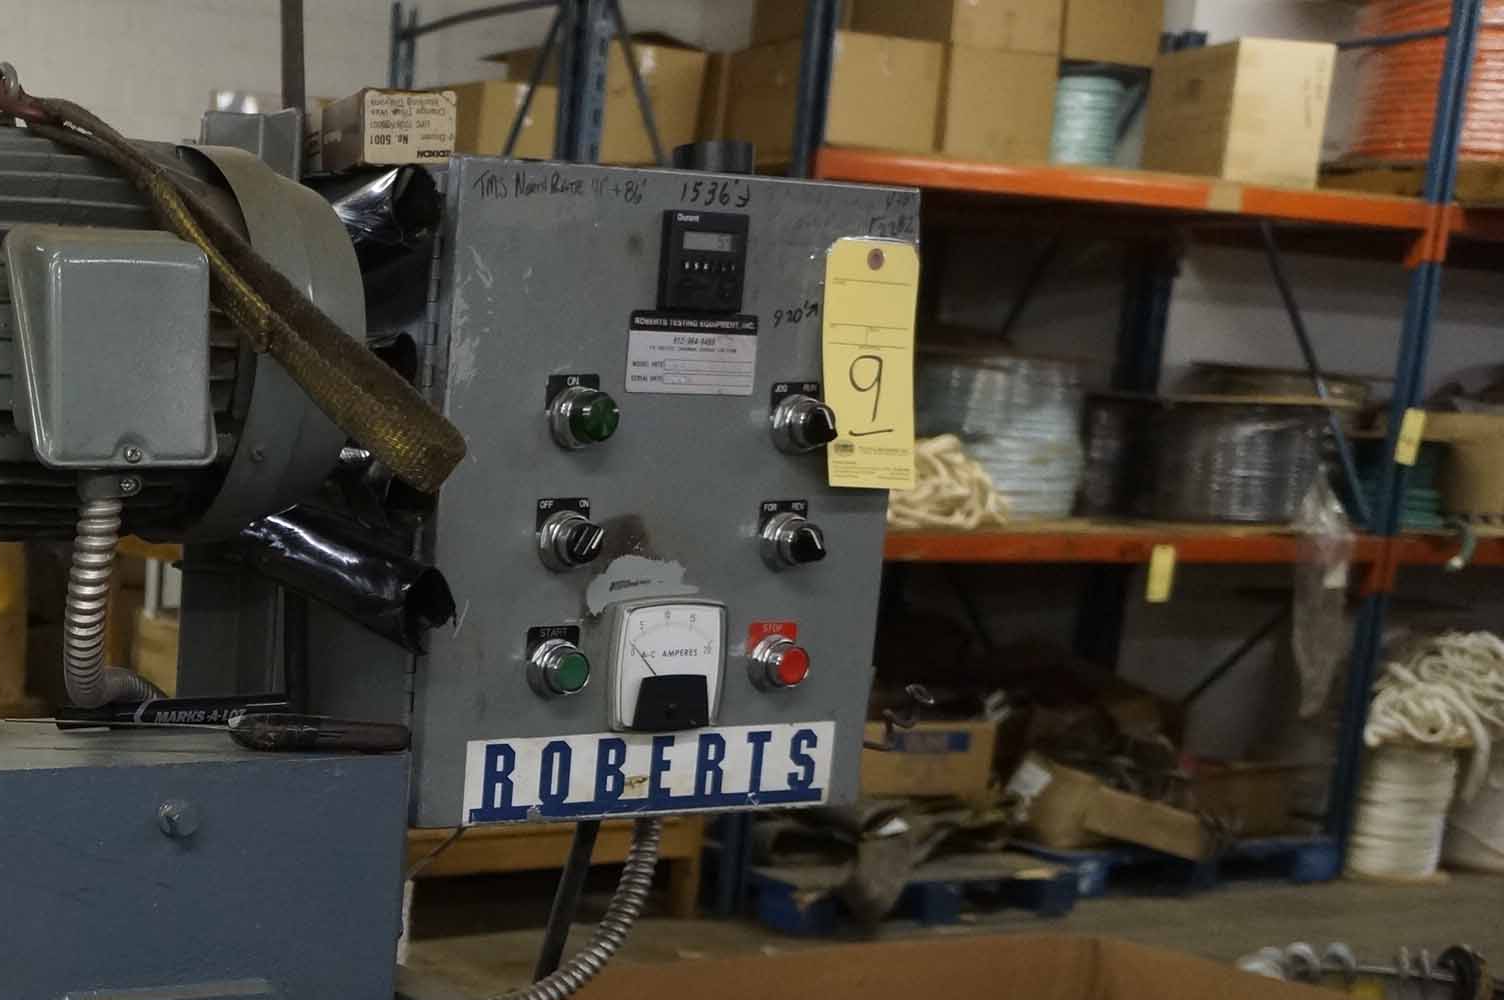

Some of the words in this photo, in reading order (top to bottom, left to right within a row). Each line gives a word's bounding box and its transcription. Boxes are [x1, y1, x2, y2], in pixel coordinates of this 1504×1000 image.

[370, 134, 392, 144] 5001
[566, 375, 581, 387] ON
[848, 354, 884, 423] 9
[538, 500, 554, 510] OFF
[578, 498, 590, 509] ON
[762, 503, 778, 513] FOR
[539, 627, 569, 639] START
[762, 623, 784, 634] STOP
[662, 648, 698, 657] AMPERES
[481, 728, 820, 809] ROBERTS
